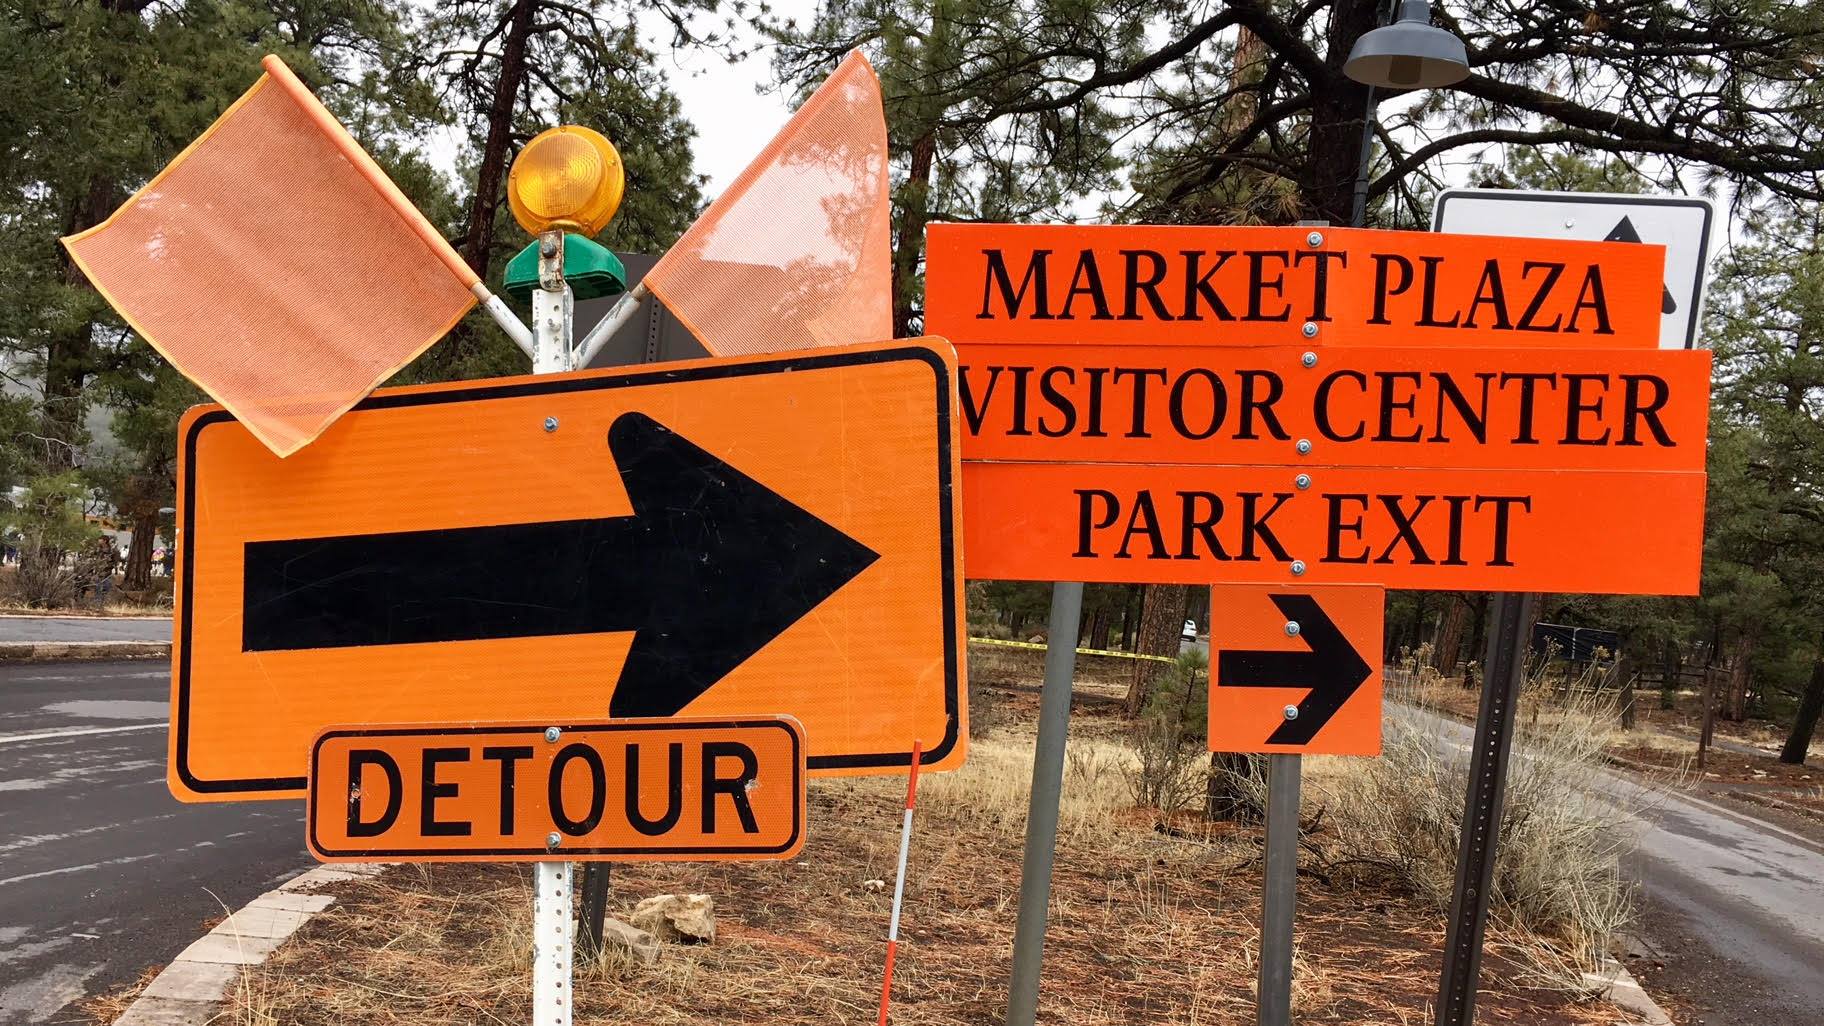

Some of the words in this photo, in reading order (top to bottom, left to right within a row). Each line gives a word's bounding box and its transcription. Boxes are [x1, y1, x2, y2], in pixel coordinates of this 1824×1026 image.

[977, 249, 1347, 323] MARKET
[1368, 254, 1614, 335] PLAZA
[958, 365, 1291, 440] VISITOR
[1314, 369, 1676, 448] CENTER
[1072, 489, 1295, 563] PARK
[1321, 493, 1531, 567] EXIT
[347, 741, 760, 838] DETOUR
